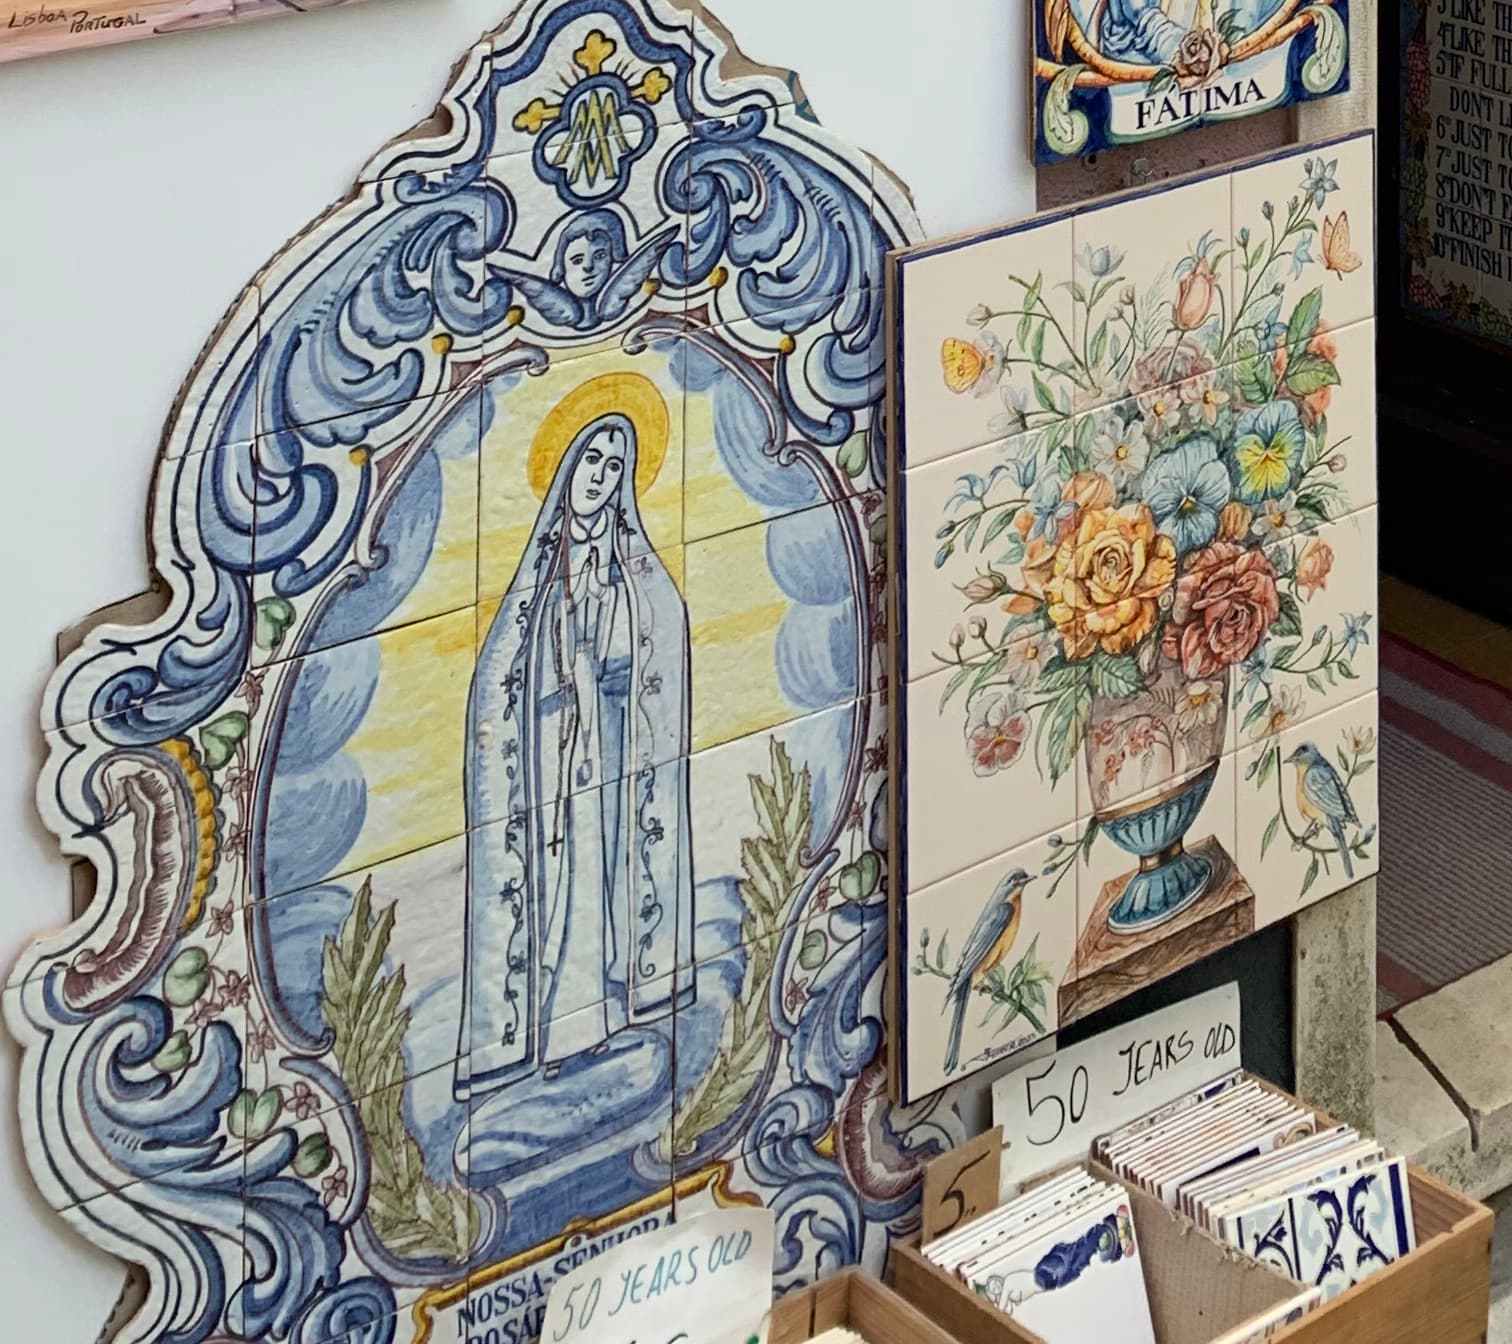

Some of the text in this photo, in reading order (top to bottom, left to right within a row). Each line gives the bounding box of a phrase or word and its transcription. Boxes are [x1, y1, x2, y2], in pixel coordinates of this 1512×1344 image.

[1450, 23, 1486, 58] LIKE
[1134, 74, 1266, 131] FÁTIMA
[1451, 119, 1492, 153] JUST
[1451, 151, 1492, 184] JUST
[1449, 207, 1493, 244] KEEP
[1449, 237, 1503, 278] FINISH
[1026, 1059, 1089, 1146] 50
[1203, 1022, 1237, 1060] OLD
[553, 1229, 753, 1342] 50 YEARS OLD
